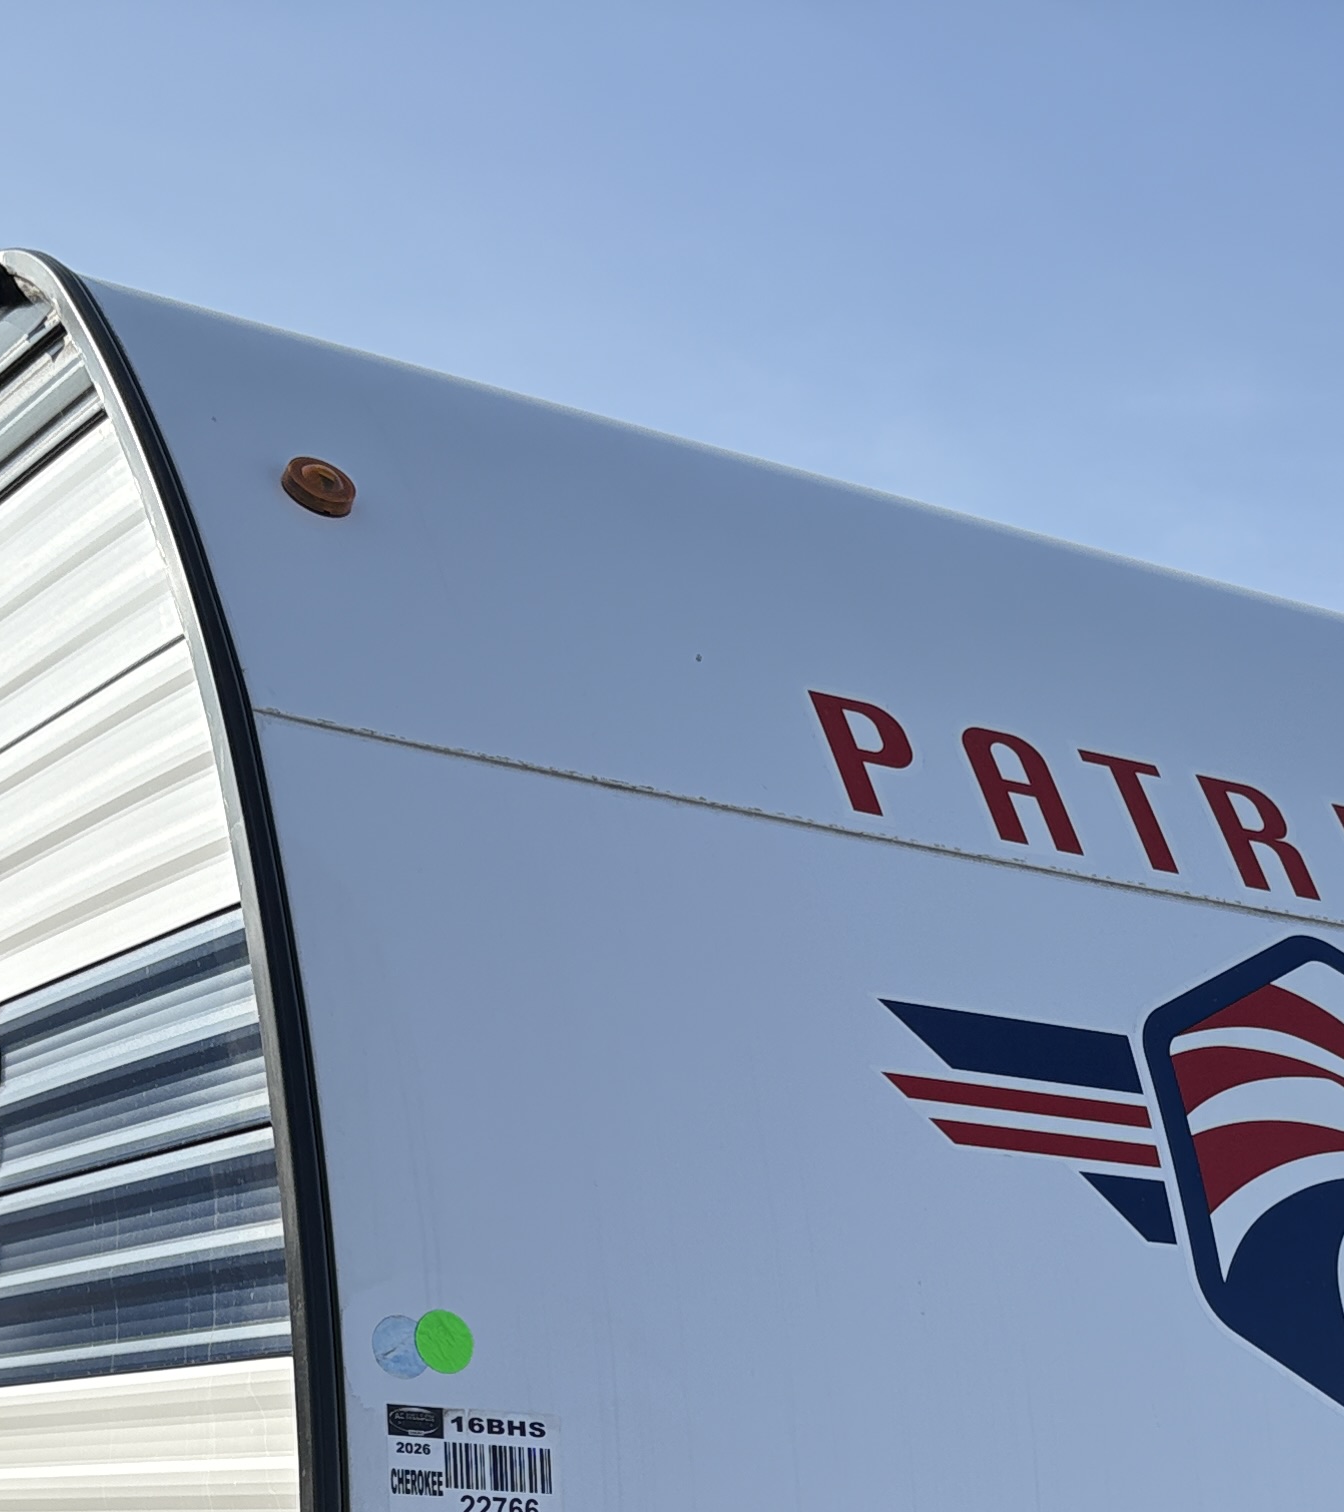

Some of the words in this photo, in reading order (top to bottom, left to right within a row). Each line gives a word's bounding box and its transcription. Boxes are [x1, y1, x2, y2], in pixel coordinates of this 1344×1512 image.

[450, 1416, 546, 1438] 16BHS
[396, 1442, 431, 1455] 2026
[390, 1468, 444, 1497] CHEROKEE
